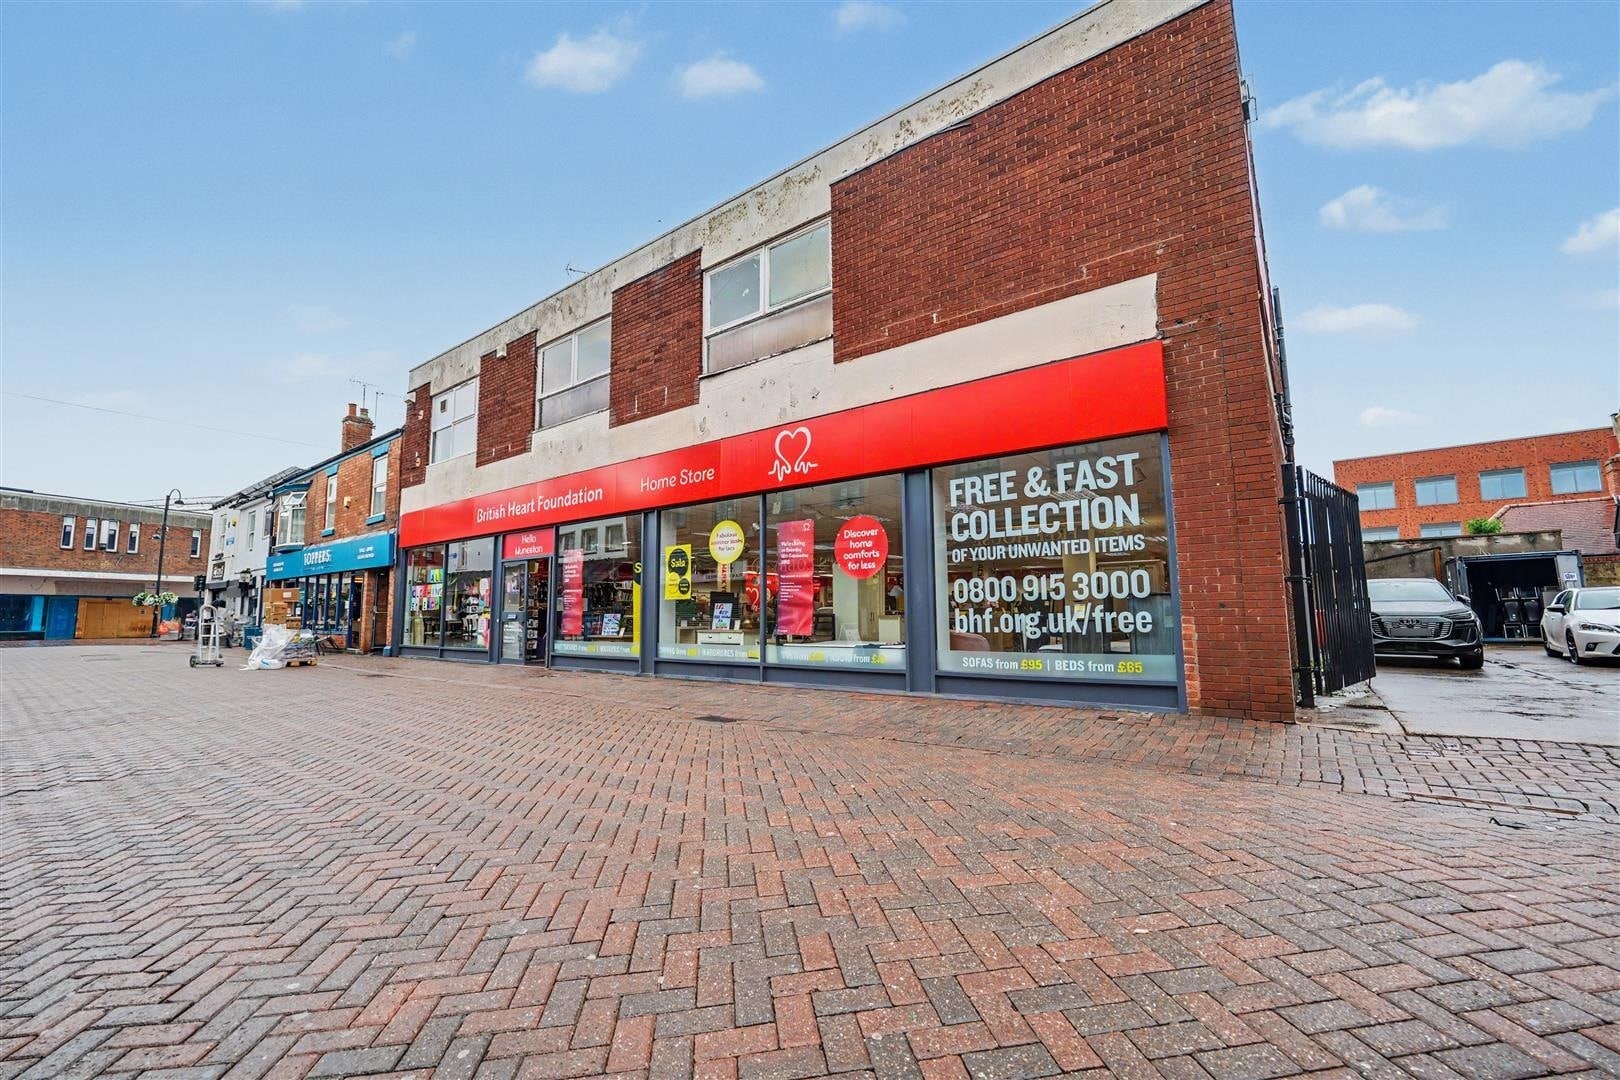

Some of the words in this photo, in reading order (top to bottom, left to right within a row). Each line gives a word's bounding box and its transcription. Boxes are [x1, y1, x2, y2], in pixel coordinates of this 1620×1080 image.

[640, 475, 677, 492] Home
[680, 468, 715, 485] Store
[949, 470, 1018, 507] FREE
[1023, 466, 1051, 498] &
[1056, 452, 1140, 494] FAST
[477, 504, 506, 522] British
[507, 498, 535, 517] Heart
[537, 486, 603, 512] Foundation
[951, 493, 1142, 543] COLLECTION
[521, 534, 536, 544] Hello
[843, 529, 879, 539] Discover
[849, 540, 873, 548] home
[843, 550, 880, 560] comforts
[951, 548, 967, 563] OF
[969, 545, 1006, 562] YOUR
[1008, 538, 1090, 560] UNWANTED
[1094, 534, 1146, 554] ITEMS
[848, 561, 860, 570] for
[861, 560, 876, 569] less
[953, 575, 1017, 603] 0800
[1022, 573, 1066, 601] 915
[1072, 569, 1150, 600] 3000
[955, 602, 1153, 639] bhf.org.uk/free
[962, 657, 993, 669] SOFAS
[995, 659, 1018, 670] from
[1055, 661, 1085, 672] BEDS
[1087, 662, 1115, 673] from
